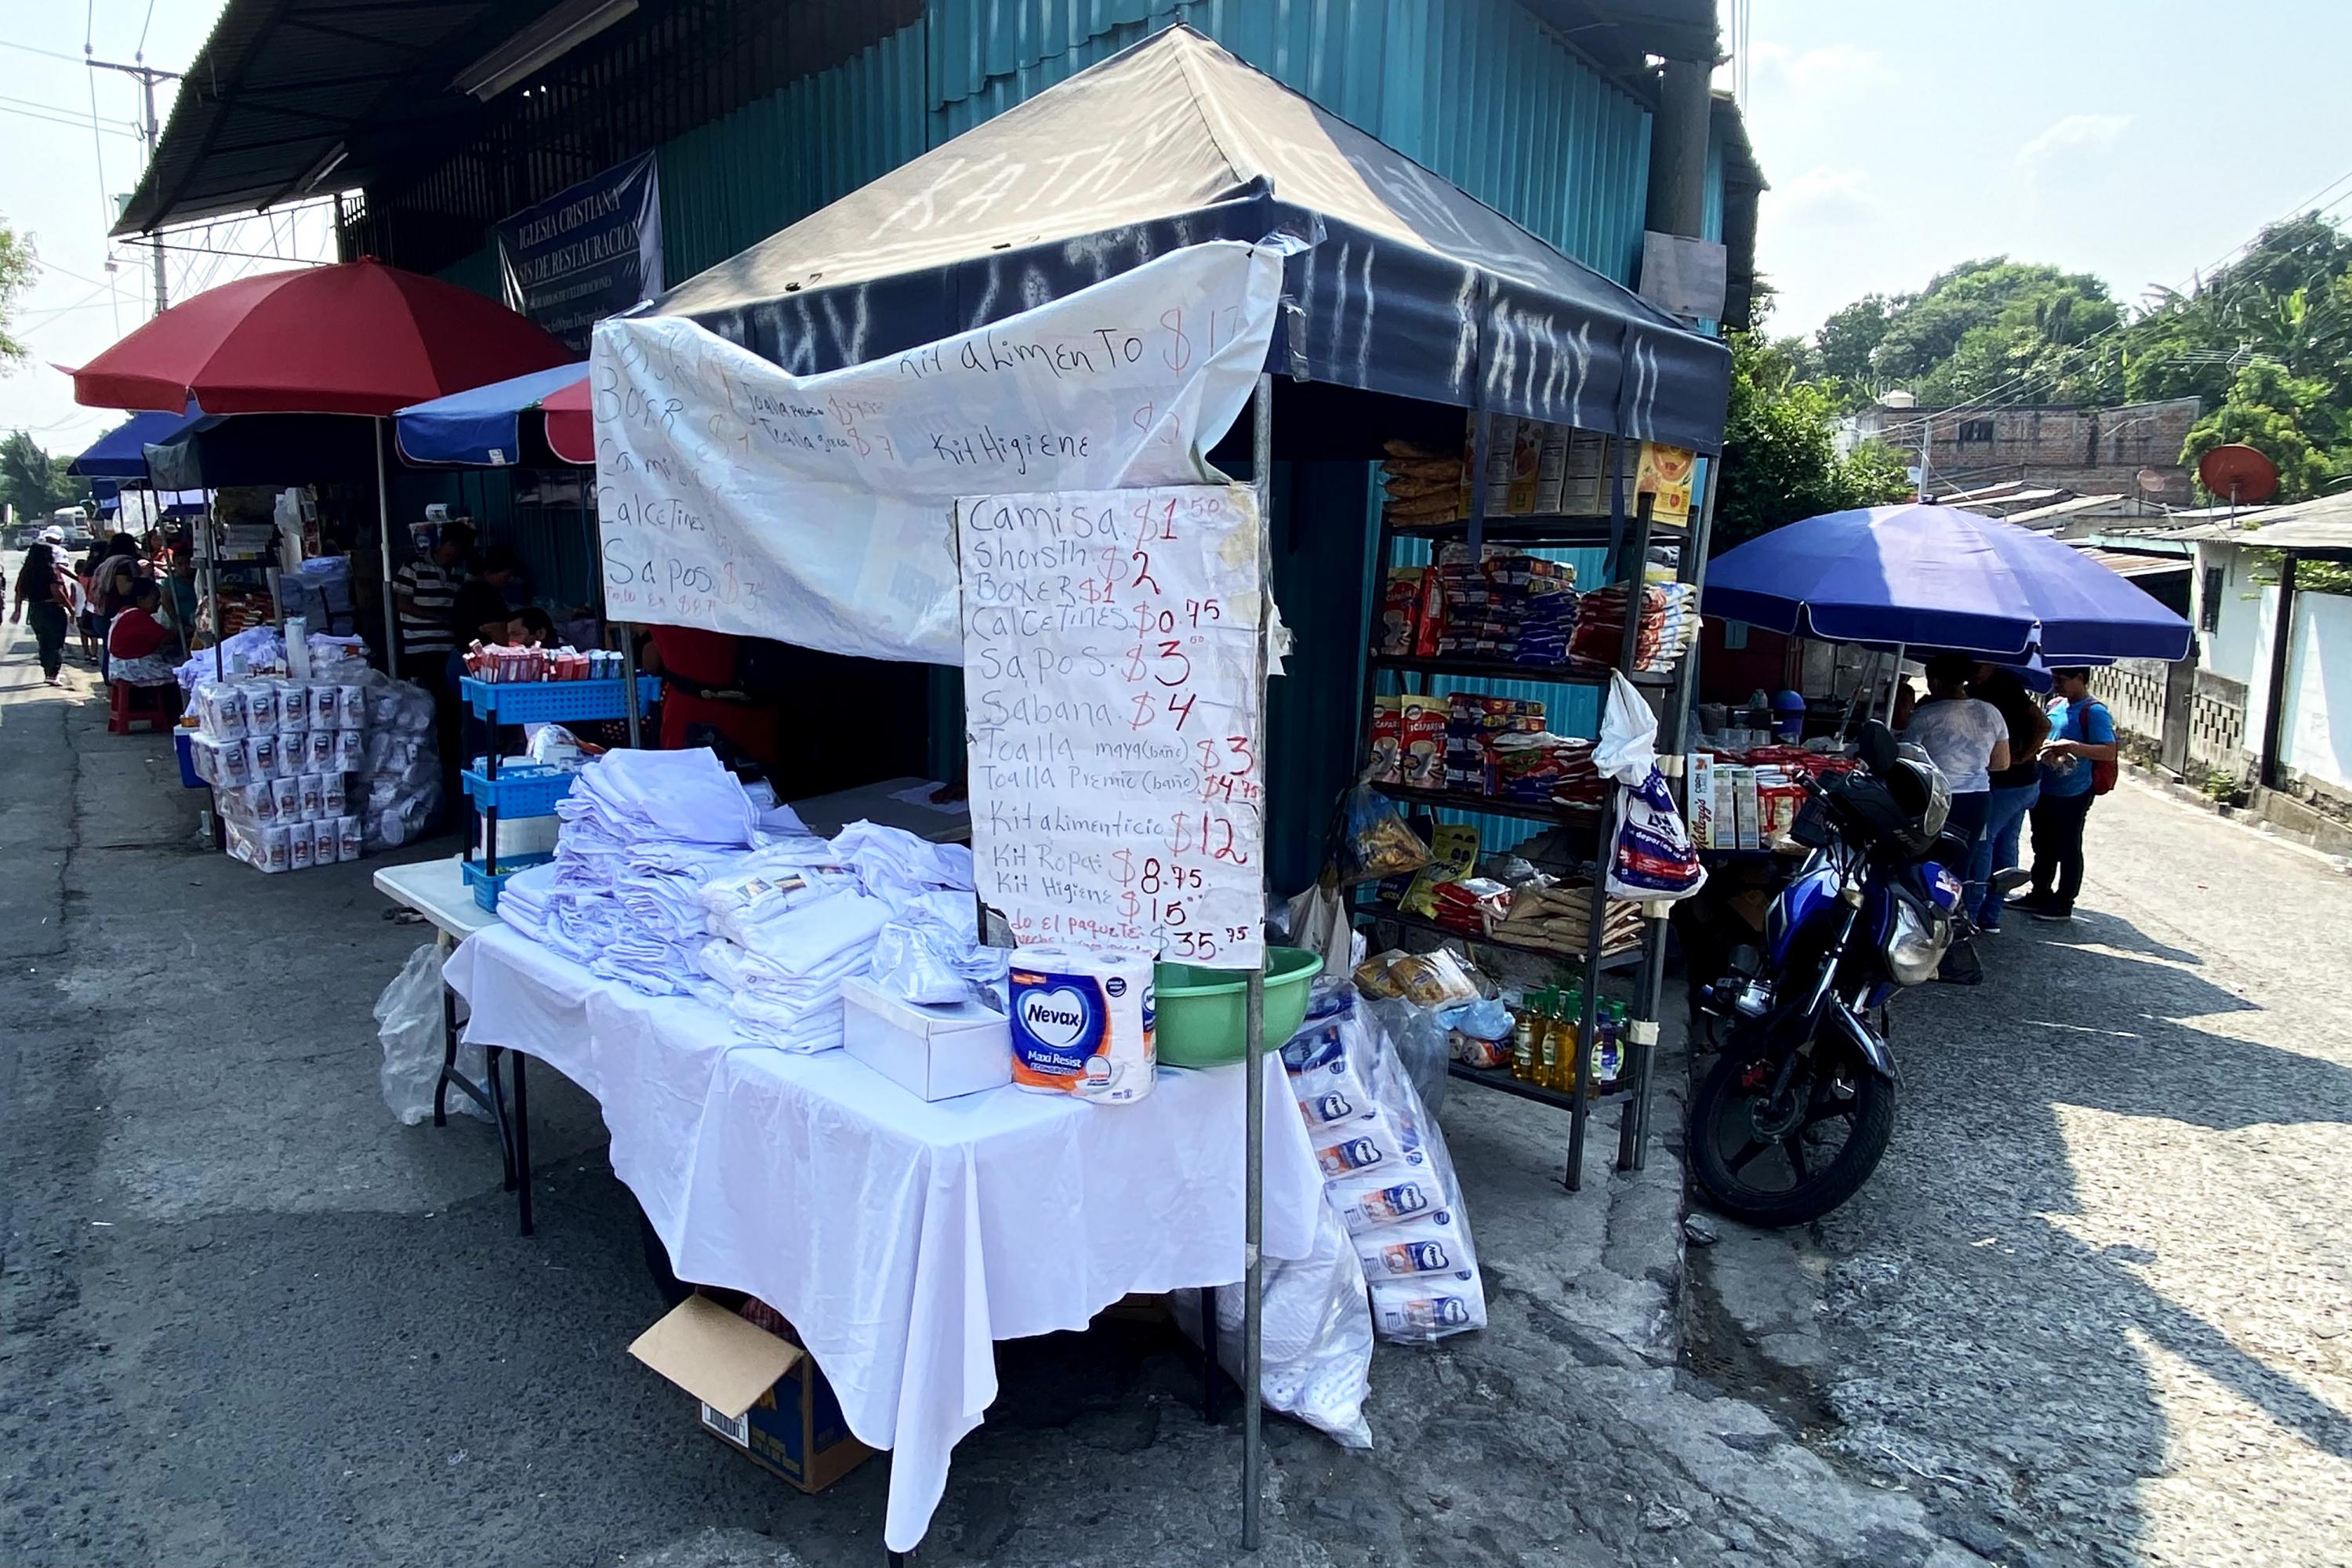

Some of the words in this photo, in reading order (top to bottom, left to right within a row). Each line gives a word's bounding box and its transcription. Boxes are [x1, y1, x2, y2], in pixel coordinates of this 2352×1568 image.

[518, 216, 557, 249] IGLESIA
[559, 190, 621, 233] CRISTIANA
[899, 343, 942, 379] Kit
[932, 431, 975, 464] Kit
[979, 727, 1075, 763] Toalla
[978, 765, 1056, 791] Toalla
[990, 800, 1032, 837] Kit
[1163, 810, 1248, 865] $12
[993, 843, 1026, 867] Kit
[996, 870, 1029, 894] Kit
[1027, 1004, 1080, 1028] Nevax
[1028, 1050, 1052, 1063] Maxi
[1052, 1053, 1082, 1068] Resist
